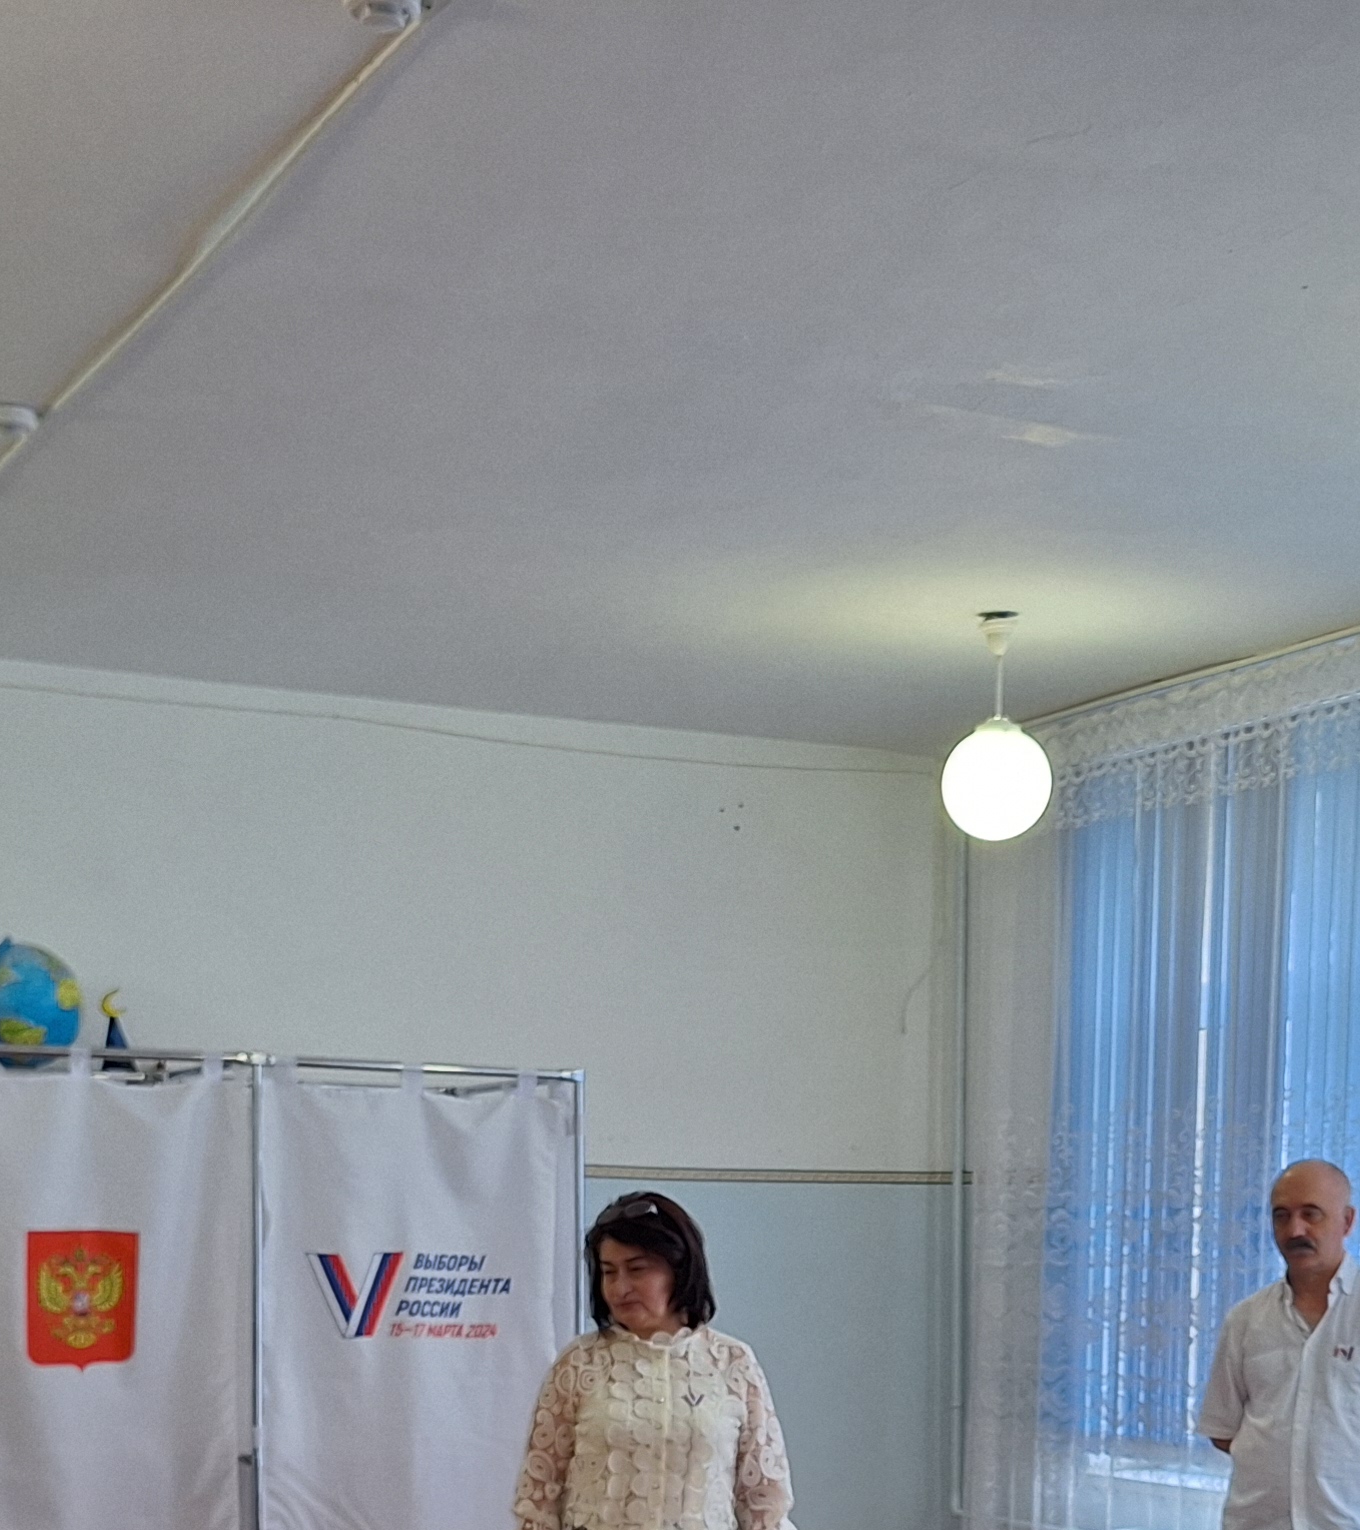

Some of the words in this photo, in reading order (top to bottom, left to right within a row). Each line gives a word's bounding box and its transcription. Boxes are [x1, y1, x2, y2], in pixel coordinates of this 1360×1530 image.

[413, 1253, 486, 1272] ВЫБОРЫ
[404, 1276, 512, 1297] ПРЕЗИДЕНТА
[395, 1299, 462, 1318] РОССИИ
[427, 1323, 463, 1338] МАРТА
[465, 1323, 498, 1339] 2024
